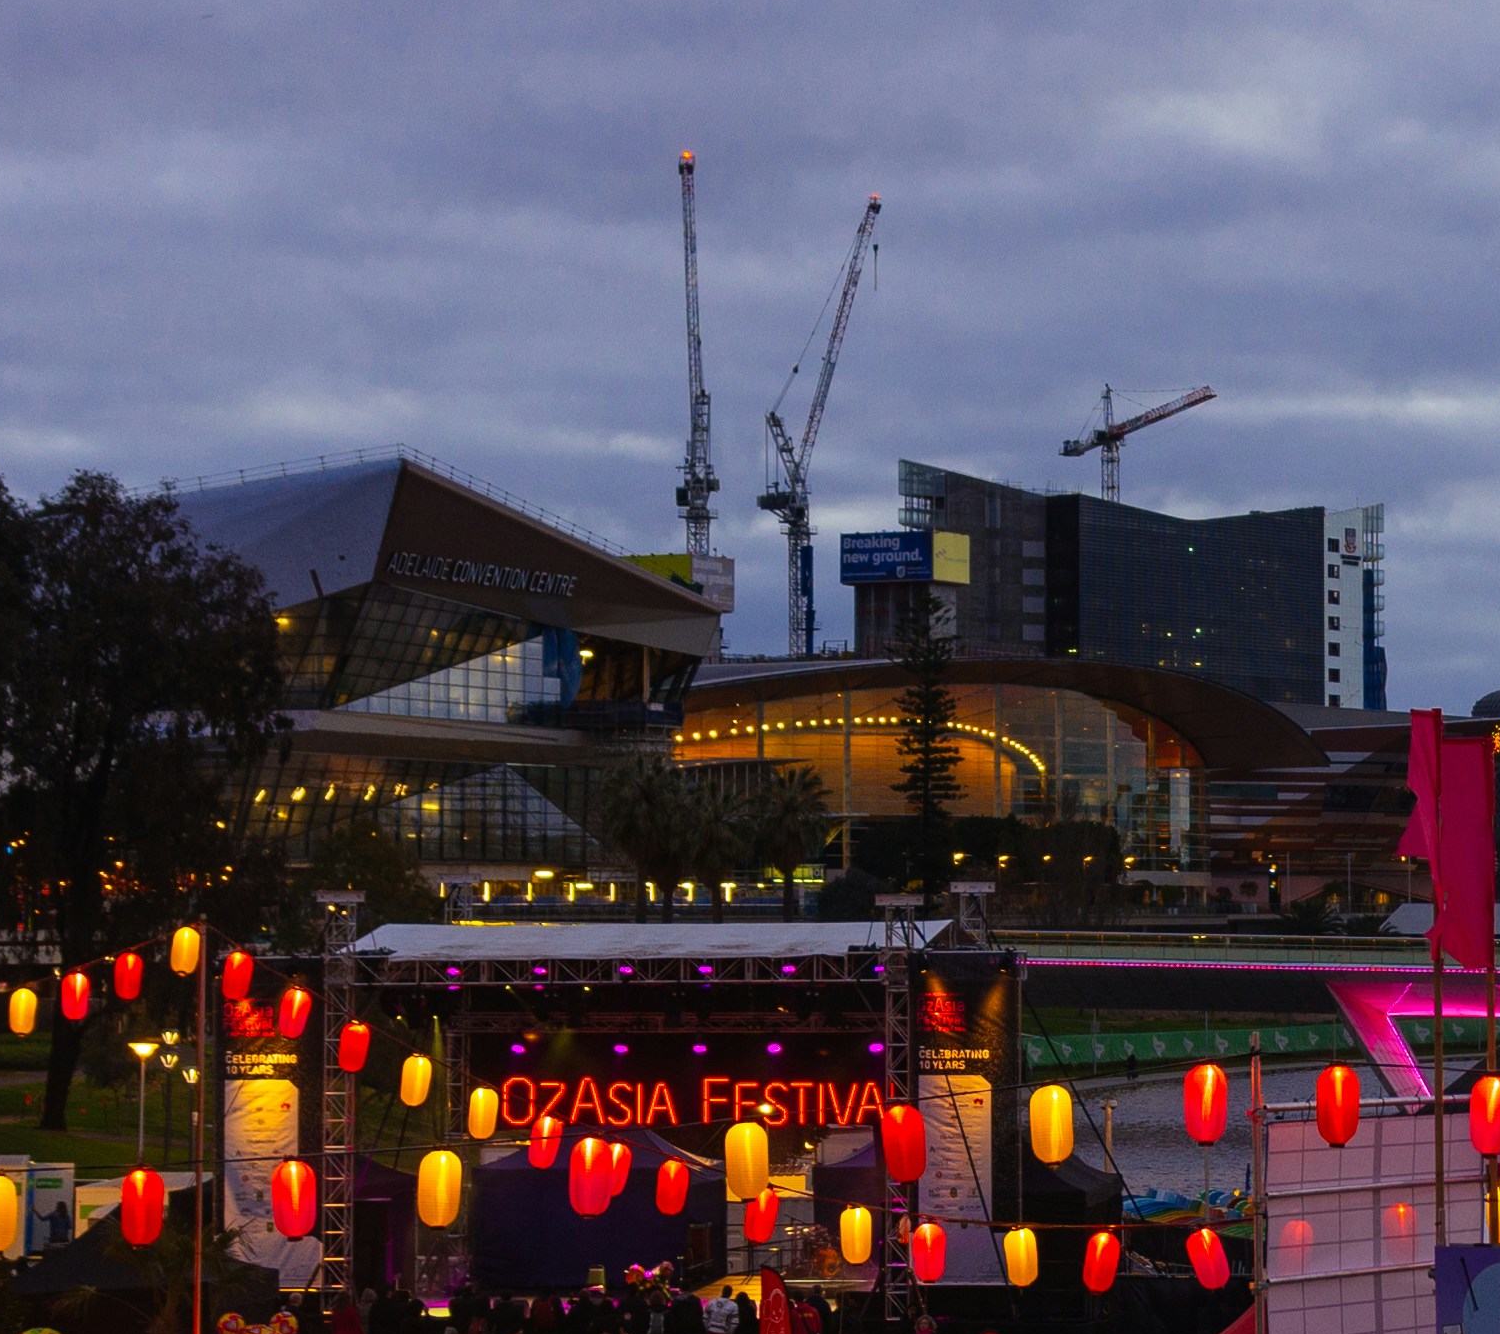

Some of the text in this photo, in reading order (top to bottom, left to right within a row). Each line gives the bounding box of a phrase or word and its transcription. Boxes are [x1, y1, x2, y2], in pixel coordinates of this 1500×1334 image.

[842, 536, 900, 550] Breaking
[842, 552, 869, 564] new
[872, 548, 923, 566] ground.
[387, 552, 578, 597] ADELAIDE CONVENTION CENTRE
[225, 1053, 298, 1064] CELEBRATING
[919, 1049, 990, 1059] CELEBRATING
[226, 1064, 274, 1075] 10 YEARS
[919, 1060, 966, 1070] 10 YEARS
